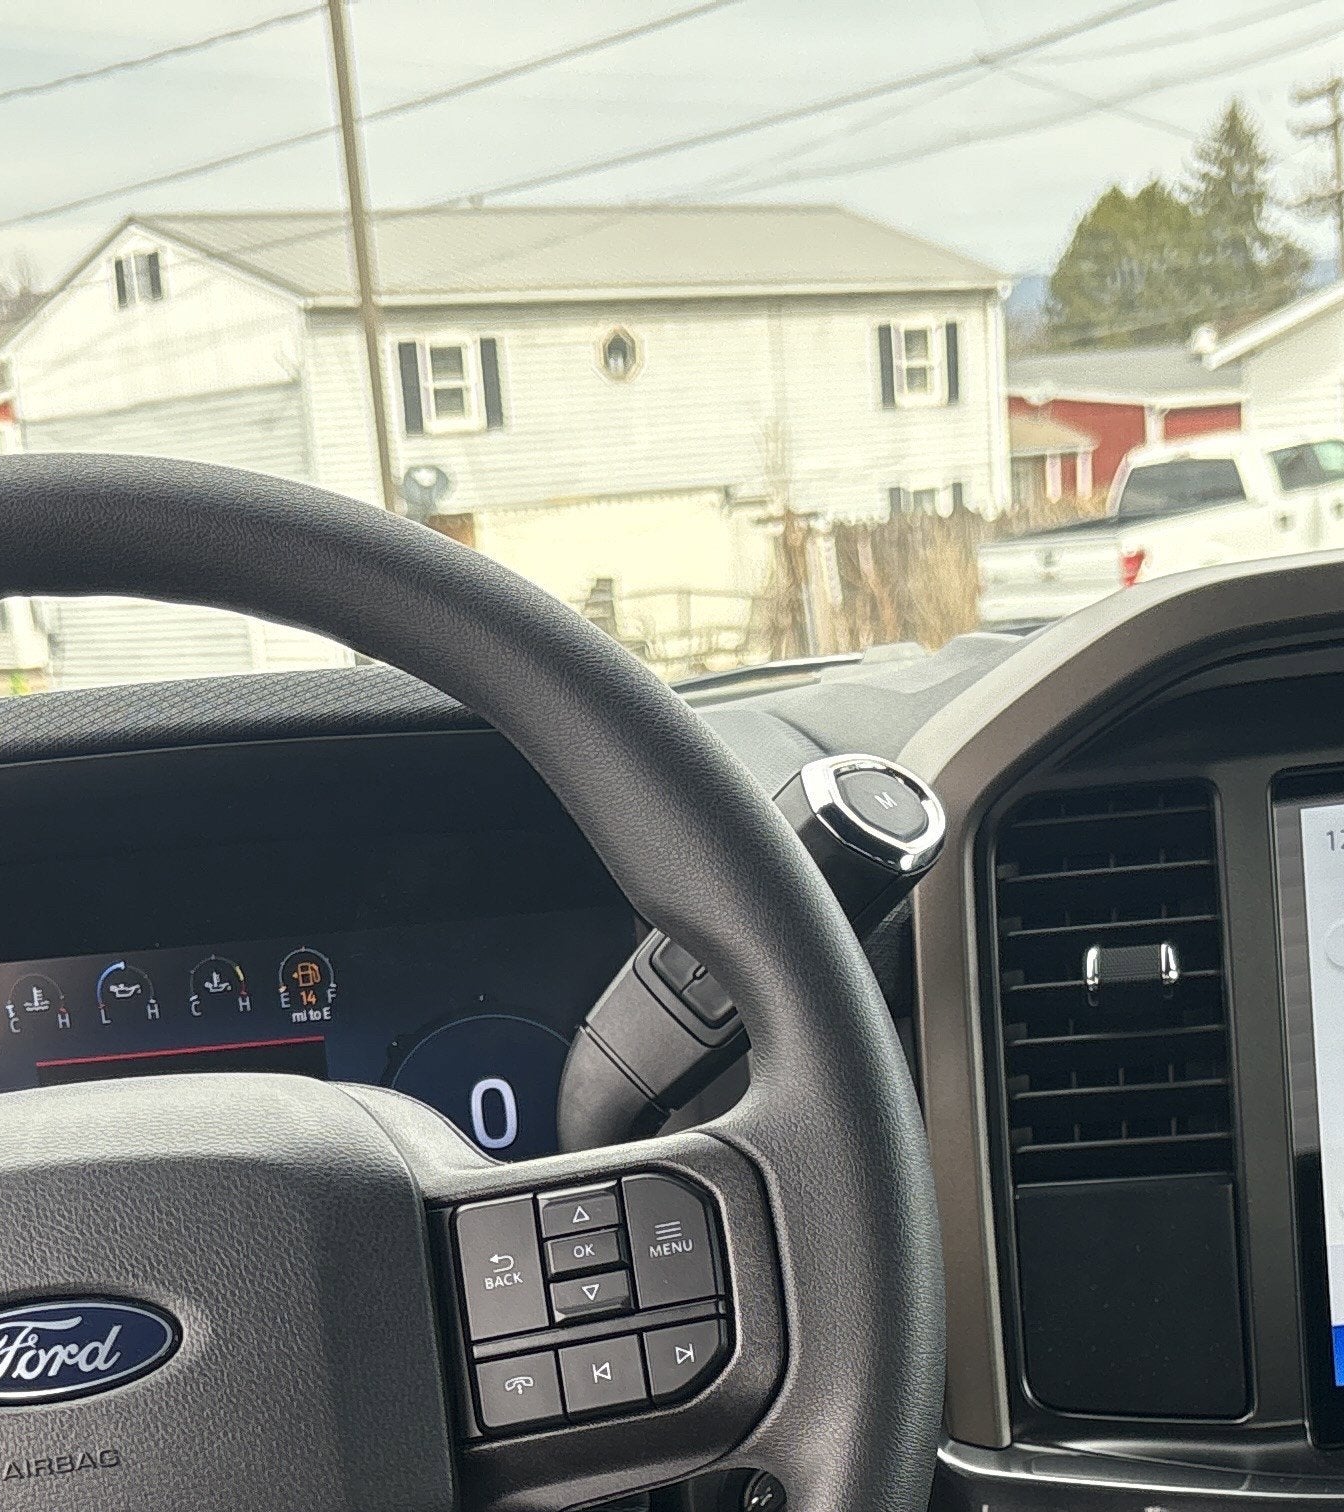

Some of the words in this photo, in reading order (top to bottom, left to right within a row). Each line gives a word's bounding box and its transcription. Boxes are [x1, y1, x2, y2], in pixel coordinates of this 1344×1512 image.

[874, 792, 897, 810] M
[238, 996, 251, 1012] H
[300, 991, 317, 1006] 14
[147, 1003, 160, 1020] H
[191, 1000, 202, 1017] C
[291, 1010, 308, 1023] mi
[309, 1009, 322, 1021] to
[323, 1007, 332, 1020] E
[9, 1017, 21, 1033] C
[57, 1013, 71, 1029] H
[100, 1009, 111, 1025] L
[468, 1076, 520, 1151] 0
[573, 1244, 595, 1258] OK
[649, 1239, 693, 1259] MENU
[484, 1272, 523, 1290] BACK
[3, 1449, 120, 1481] AIRBAG
